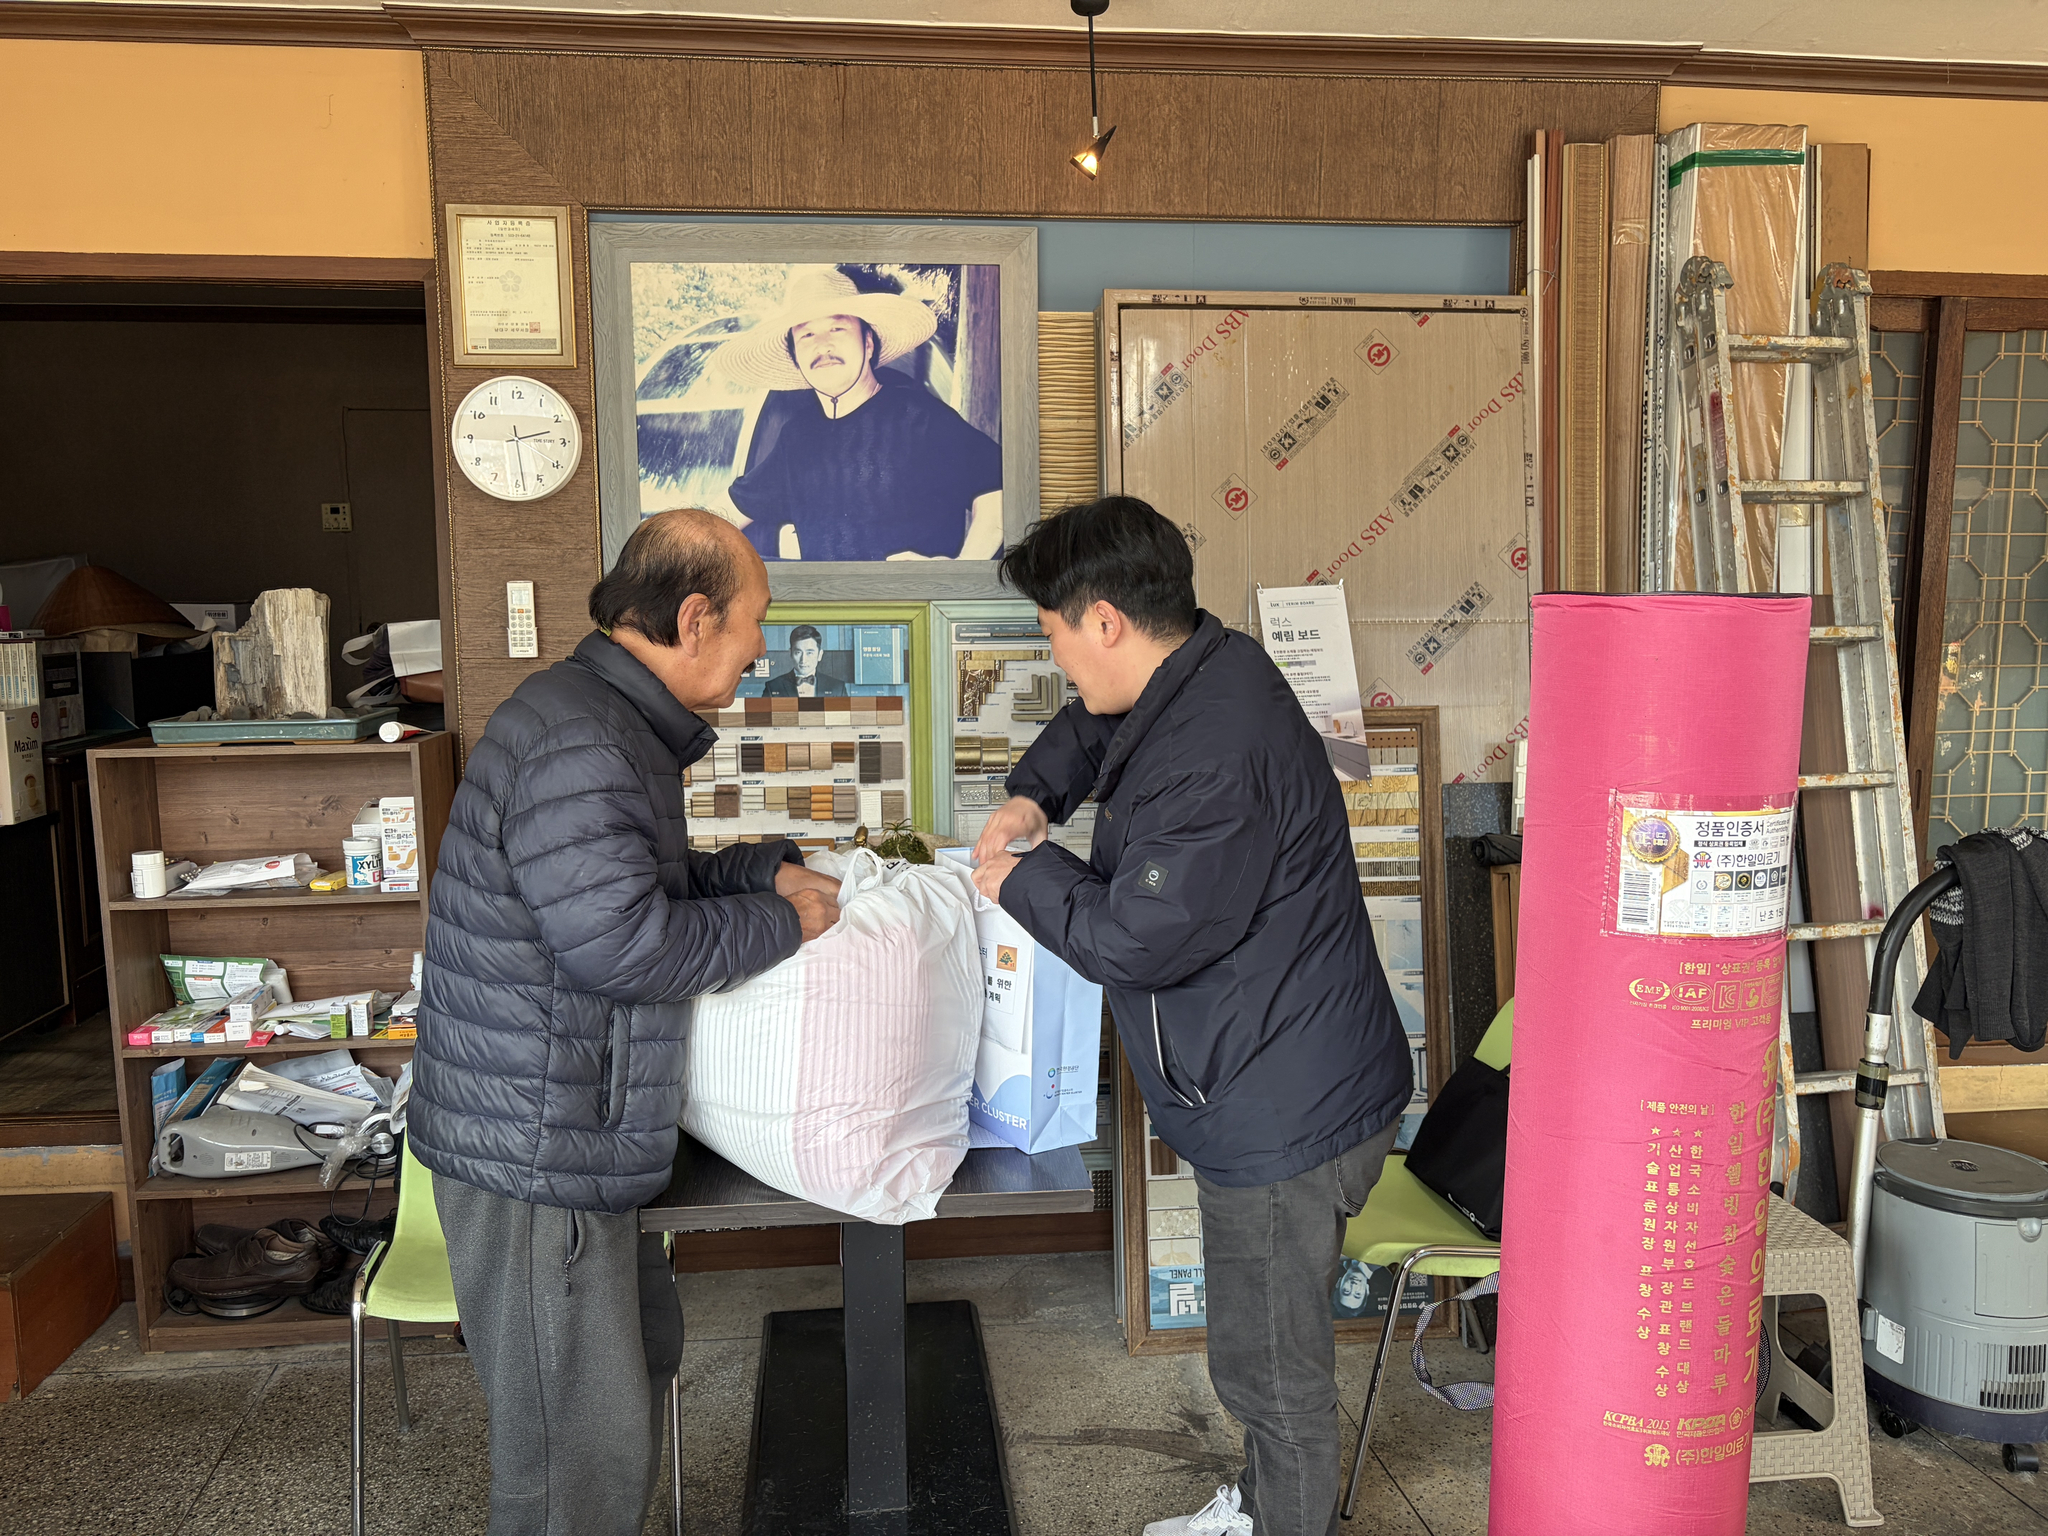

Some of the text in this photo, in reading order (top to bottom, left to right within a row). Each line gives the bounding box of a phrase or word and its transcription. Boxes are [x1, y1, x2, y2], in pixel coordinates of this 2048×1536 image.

[1181, 335, 1218, 371] Door
[489, 396, 498, 405] 11
[511, 390, 524, 400] 12
[539, 398, 543, 407] 1
[1467, 371, 1523, 433] BS Door
[473, 411, 485, 420] 10
[553, 414, 562, 423] 2
[467, 434, 474, 443] 9
[559, 438, 567, 447] 3
[475, 457, 481, 466] 8
[552, 460, 559, 469] 4
[491, 472, 498, 482] 7
[514, 479, 521, 488] 6
[537, 474, 544, 483] 5
[1326, 506, 1394, 578] ABS Door
[1270, 617, 1292, 628] 럭스
[1272, 629, 1321, 642] 예림 보드
[14, 737, 38, 753] Maxim
[1472, 715, 1529, 781] BS Door
[1695, 820, 1764, 837] 정품인증서
[358, 859, 381, 870] XYLIT
[1716, 851, 1780, 868] (주)한일의료기
[1679, 962, 1711, 976] [한일]
[1755, 958, 1771, 973] 등록
[996, 978, 1012, 991] 위한
[1636, 984, 1664, 994] EMF
[1678, 987, 1708, 999] IAF
[1690, 1012, 1771, 1031] 프리미엄 VIP 고객용
[1646, 1101, 1667, 1113] 제품
[1669, 1103, 1697, 1115] 안전의
[981, 1102, 1027, 1131] CLUSTER
[1169, 1268, 1191, 1279] PANEL
[1659, 1281, 1674, 1314] 장관
[1636, 1307, 1652, 1340] 수상
[1677, 1302, 1693, 1350] 브랜드
[1657, 1324, 1671, 1356] 표창
[1654, 1365, 1669, 1397] 수상
[1676, 1362, 1690, 1394] 대상
[1603, 1411, 1671, 1430] KCPBA 2015
[1675, 1430, 1750, 1466] (주)한일의료기
